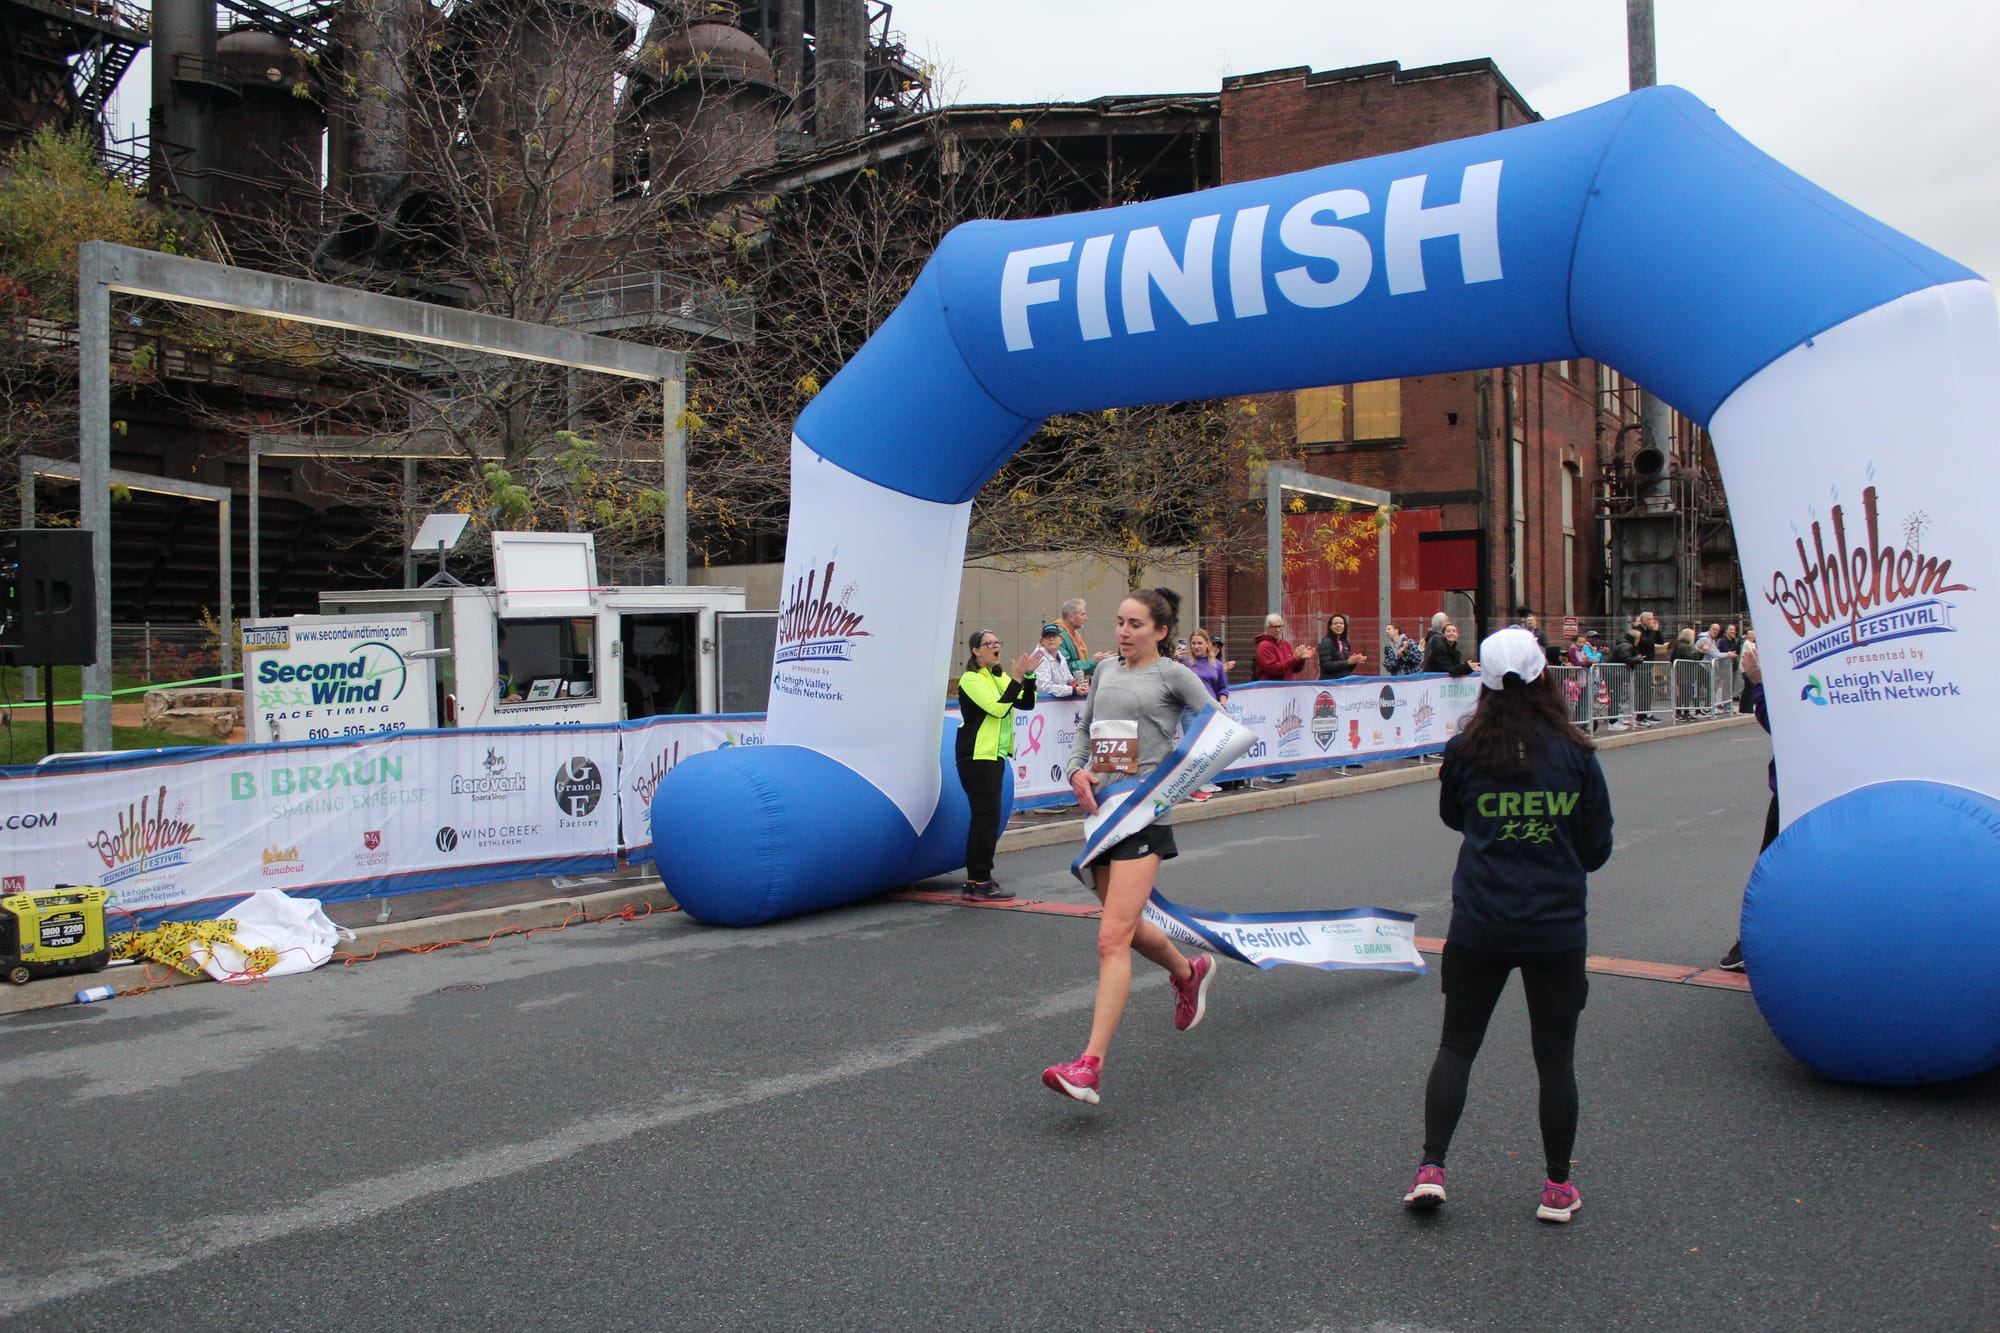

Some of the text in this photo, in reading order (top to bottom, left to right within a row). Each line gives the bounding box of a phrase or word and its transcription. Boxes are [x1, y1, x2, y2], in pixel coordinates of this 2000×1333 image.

[1000, 160, 1504, 352] FINISH
[1764, 486, 1976, 645] Bethlehem
[295, 626, 407, 642] www.secondwindtiming.com
[1796, 609, 1938, 662] RUNNING FESTIVAL
[802, 644, 844, 656] FESTIVAL
[1846, 647, 1924, 666] presented by
[258, 656, 366, 684] Second
[1826, 668, 1934, 689] Lehigh Valley
[311, 679, 382, 705] Wind
[782, 673, 832, 691] Lehigh Valley
[782, 684, 843, 701] Health Network
[1829, 682, 1960, 704] Health Network
[265, 704, 391, 721] RACE TIMING
[1096, 741, 1128, 754] 2574
[1209, 727, 1235, 760] Institute
[230, 756, 402, 801] B BRAUN
[451, 772, 526, 795] Aardvark
[1162, 750, 1209, 799] Lehigh Valley
[1170, 761, 1211, 804] Orthopedic
[556, 782, 601, 792] Granola
[272, 788, 427, 819] SHARING EXPERTISE
[1477, 791, 1579, 817] CREW
[88, 785, 204, 869] Bethlehem
[461, 825, 539, 840] WIND CREEK
[559, 819, 599, 829] Factory
[479, 838, 522, 848] BETHLEHEM
[104, 852, 183, 883] RUNNING FESTIVAL
[262, 864, 305, 877] Runabout
[153, 888, 187, 900] Network
[42, 924, 84, 936] 1800 2200
[1236, 926, 1311, 949] Festival
[1364, 944, 1392, 954] BRAUN
